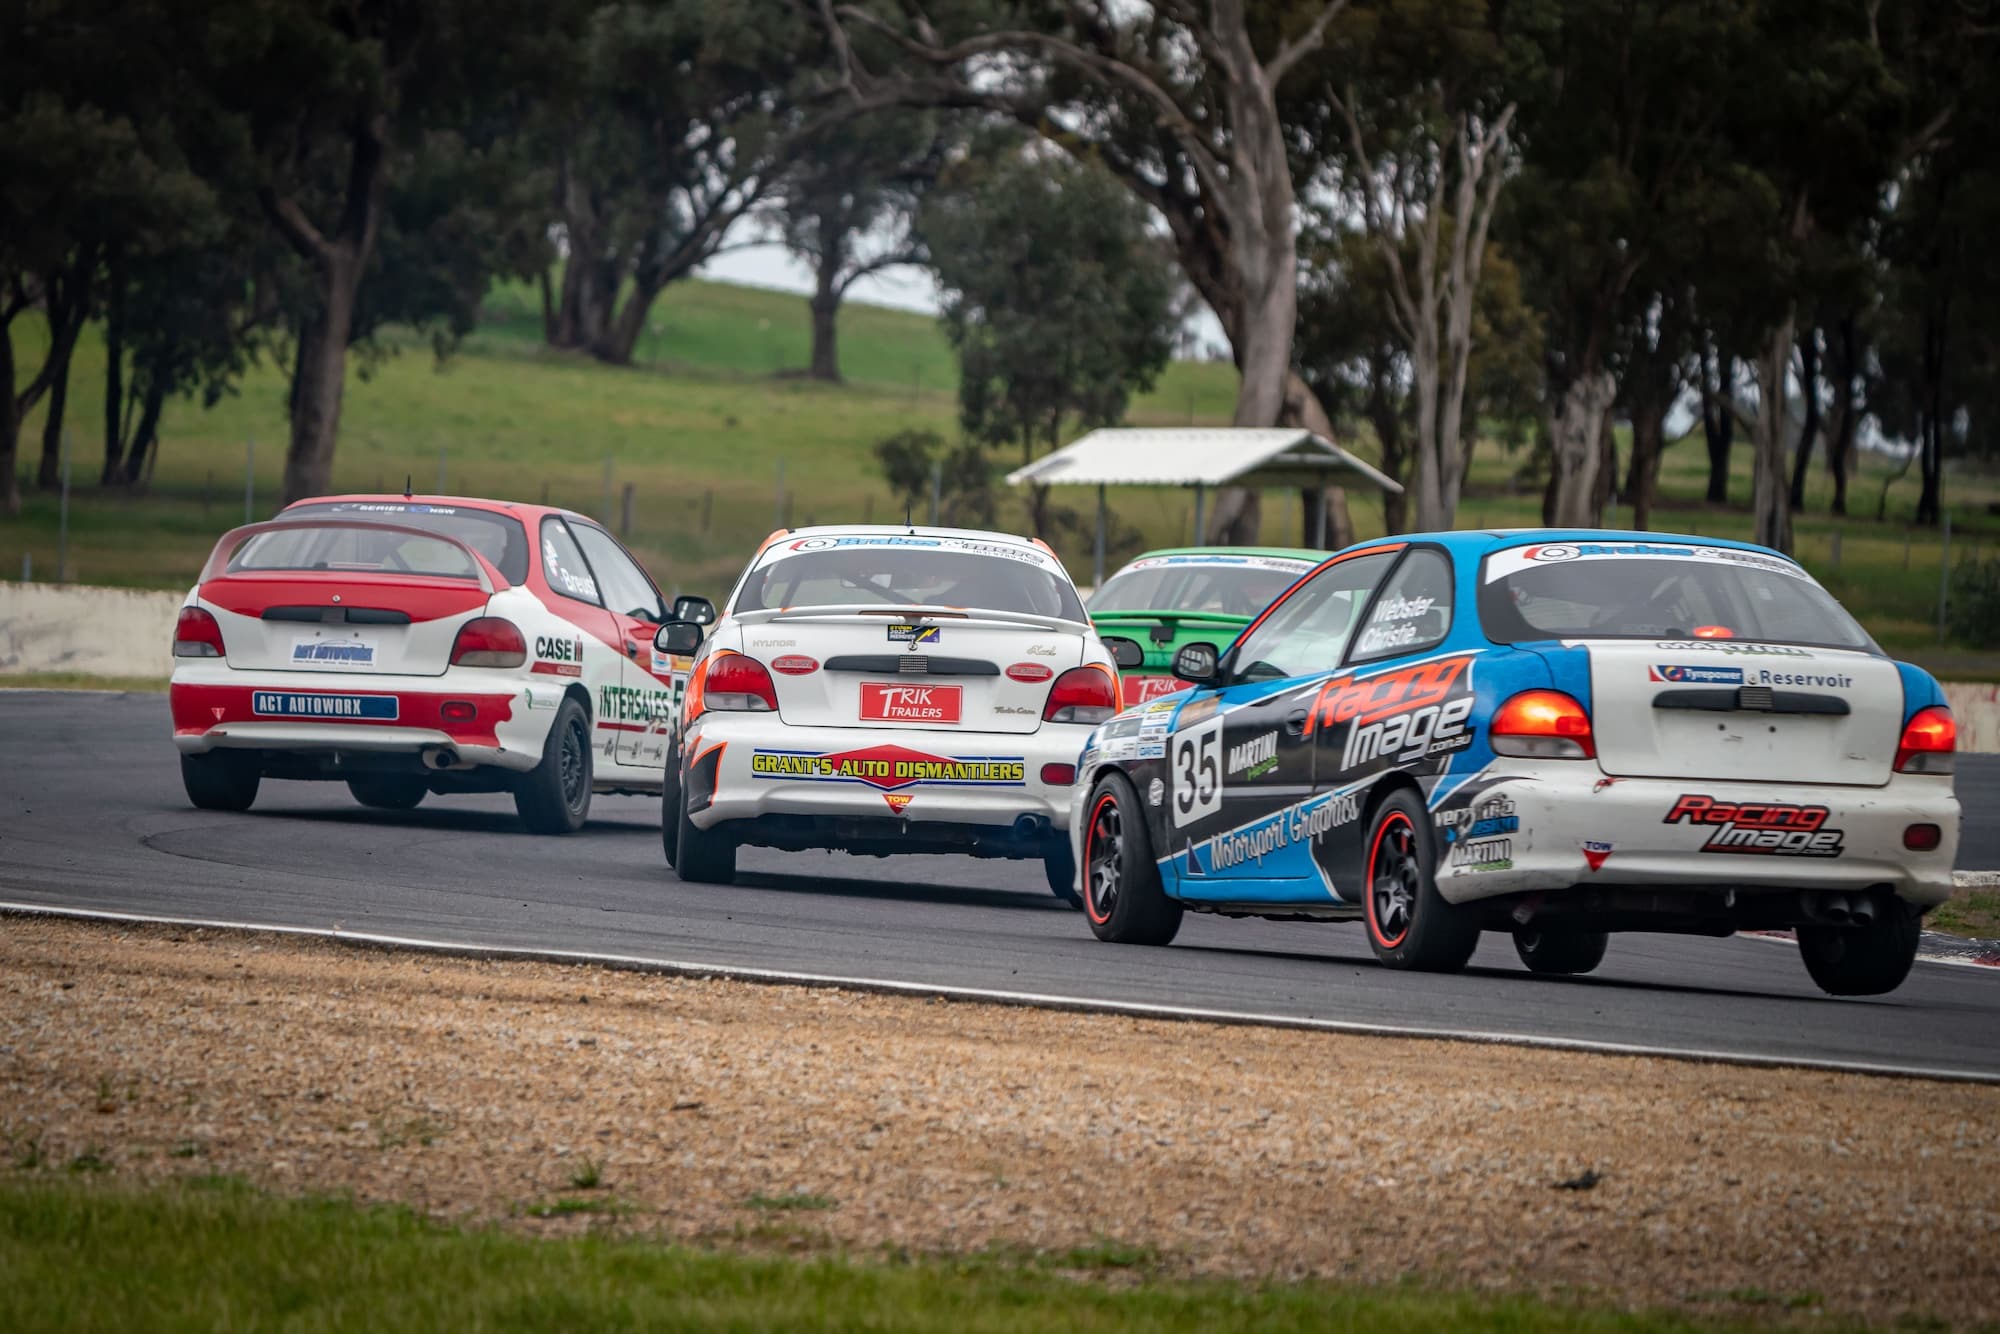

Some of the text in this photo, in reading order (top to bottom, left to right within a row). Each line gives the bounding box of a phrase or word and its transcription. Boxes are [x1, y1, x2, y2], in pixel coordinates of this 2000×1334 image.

[359, 504, 405, 512] SERIES
[1578, 544, 1694, 557] Brakes
[1372, 595, 1436, 623] Webster
[535, 636, 572, 660] CASE
[752, 639, 797, 648] HYUNDAI
[1361, 621, 1417, 652] Christie
[1684, 667, 1853, 689] Tyrepower Reservoir
[258, 695, 362, 716] ACT AUTOWORX
[879, 687, 933, 718] TRIK
[1302, 656, 1474, 737] Racing
[890, 707, 943, 719] TRAILERS
[1339, 697, 1475, 772] Image
[1228, 730, 1279, 775] MARTINI
[752, 754, 1025, 781] GRANT'S AUTO DISMANTLERS
[1177, 729, 1217, 814] 35
[887, 795, 910, 804] TOW
[1665, 795, 1830, 832] Racing
[1210, 790, 1361, 873] Motorsport Graphics
[1584, 840, 1613, 851] TOW
[1714, 821, 1843, 851] Image
[1451, 839, 1512, 868] MARTINI
